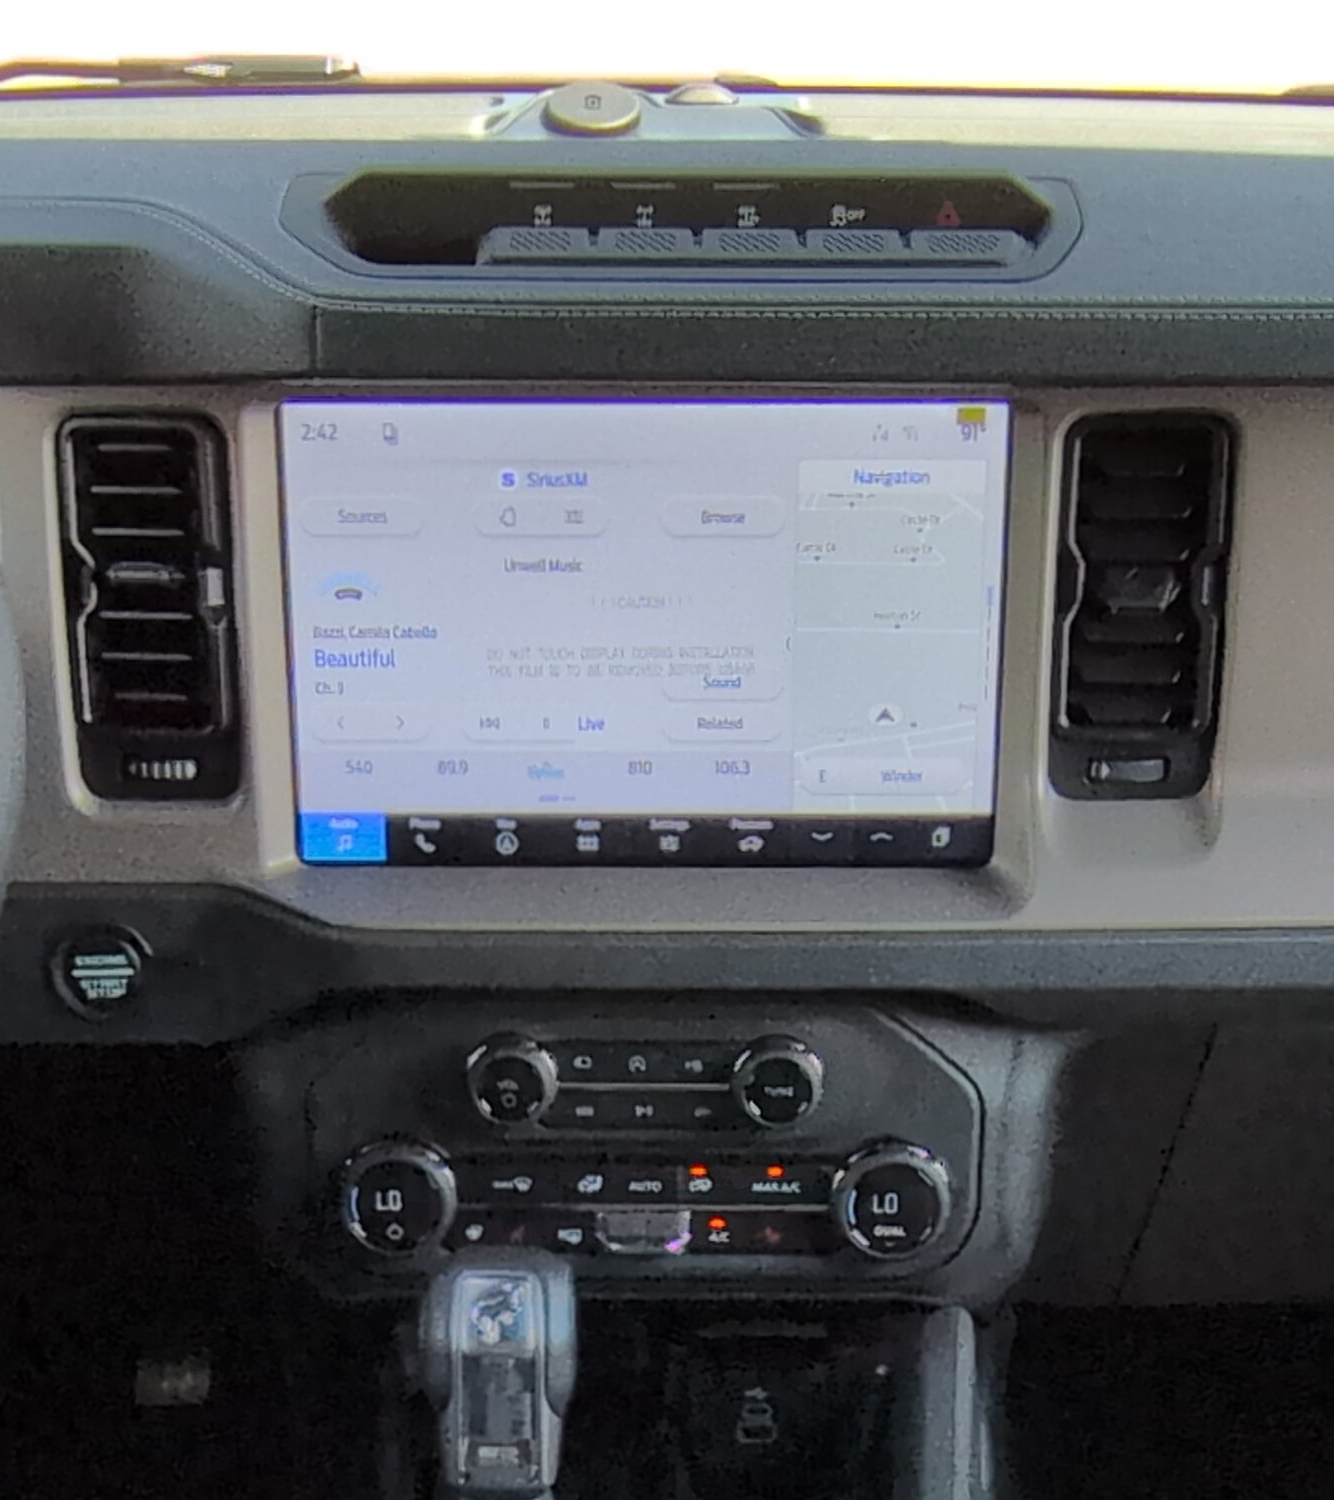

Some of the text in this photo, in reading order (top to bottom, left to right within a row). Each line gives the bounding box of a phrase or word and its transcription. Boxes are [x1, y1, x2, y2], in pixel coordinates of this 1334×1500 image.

[301, 423, 338, 441] 2:42
[853, 468, 930, 486] Navigation
[549, 557, 583, 574] Music
[315, 648, 395, 668] Beautiful
[578, 717, 605, 732] Live
[345, 761, 373, 775] 540
[628, 761, 653, 775] 810
[715, 761, 751, 776] 106.3
[628, 1181, 663, 1193] AUTO
[376, 1189, 403, 1212] LO
[872, 1192, 899, 1215] LO
